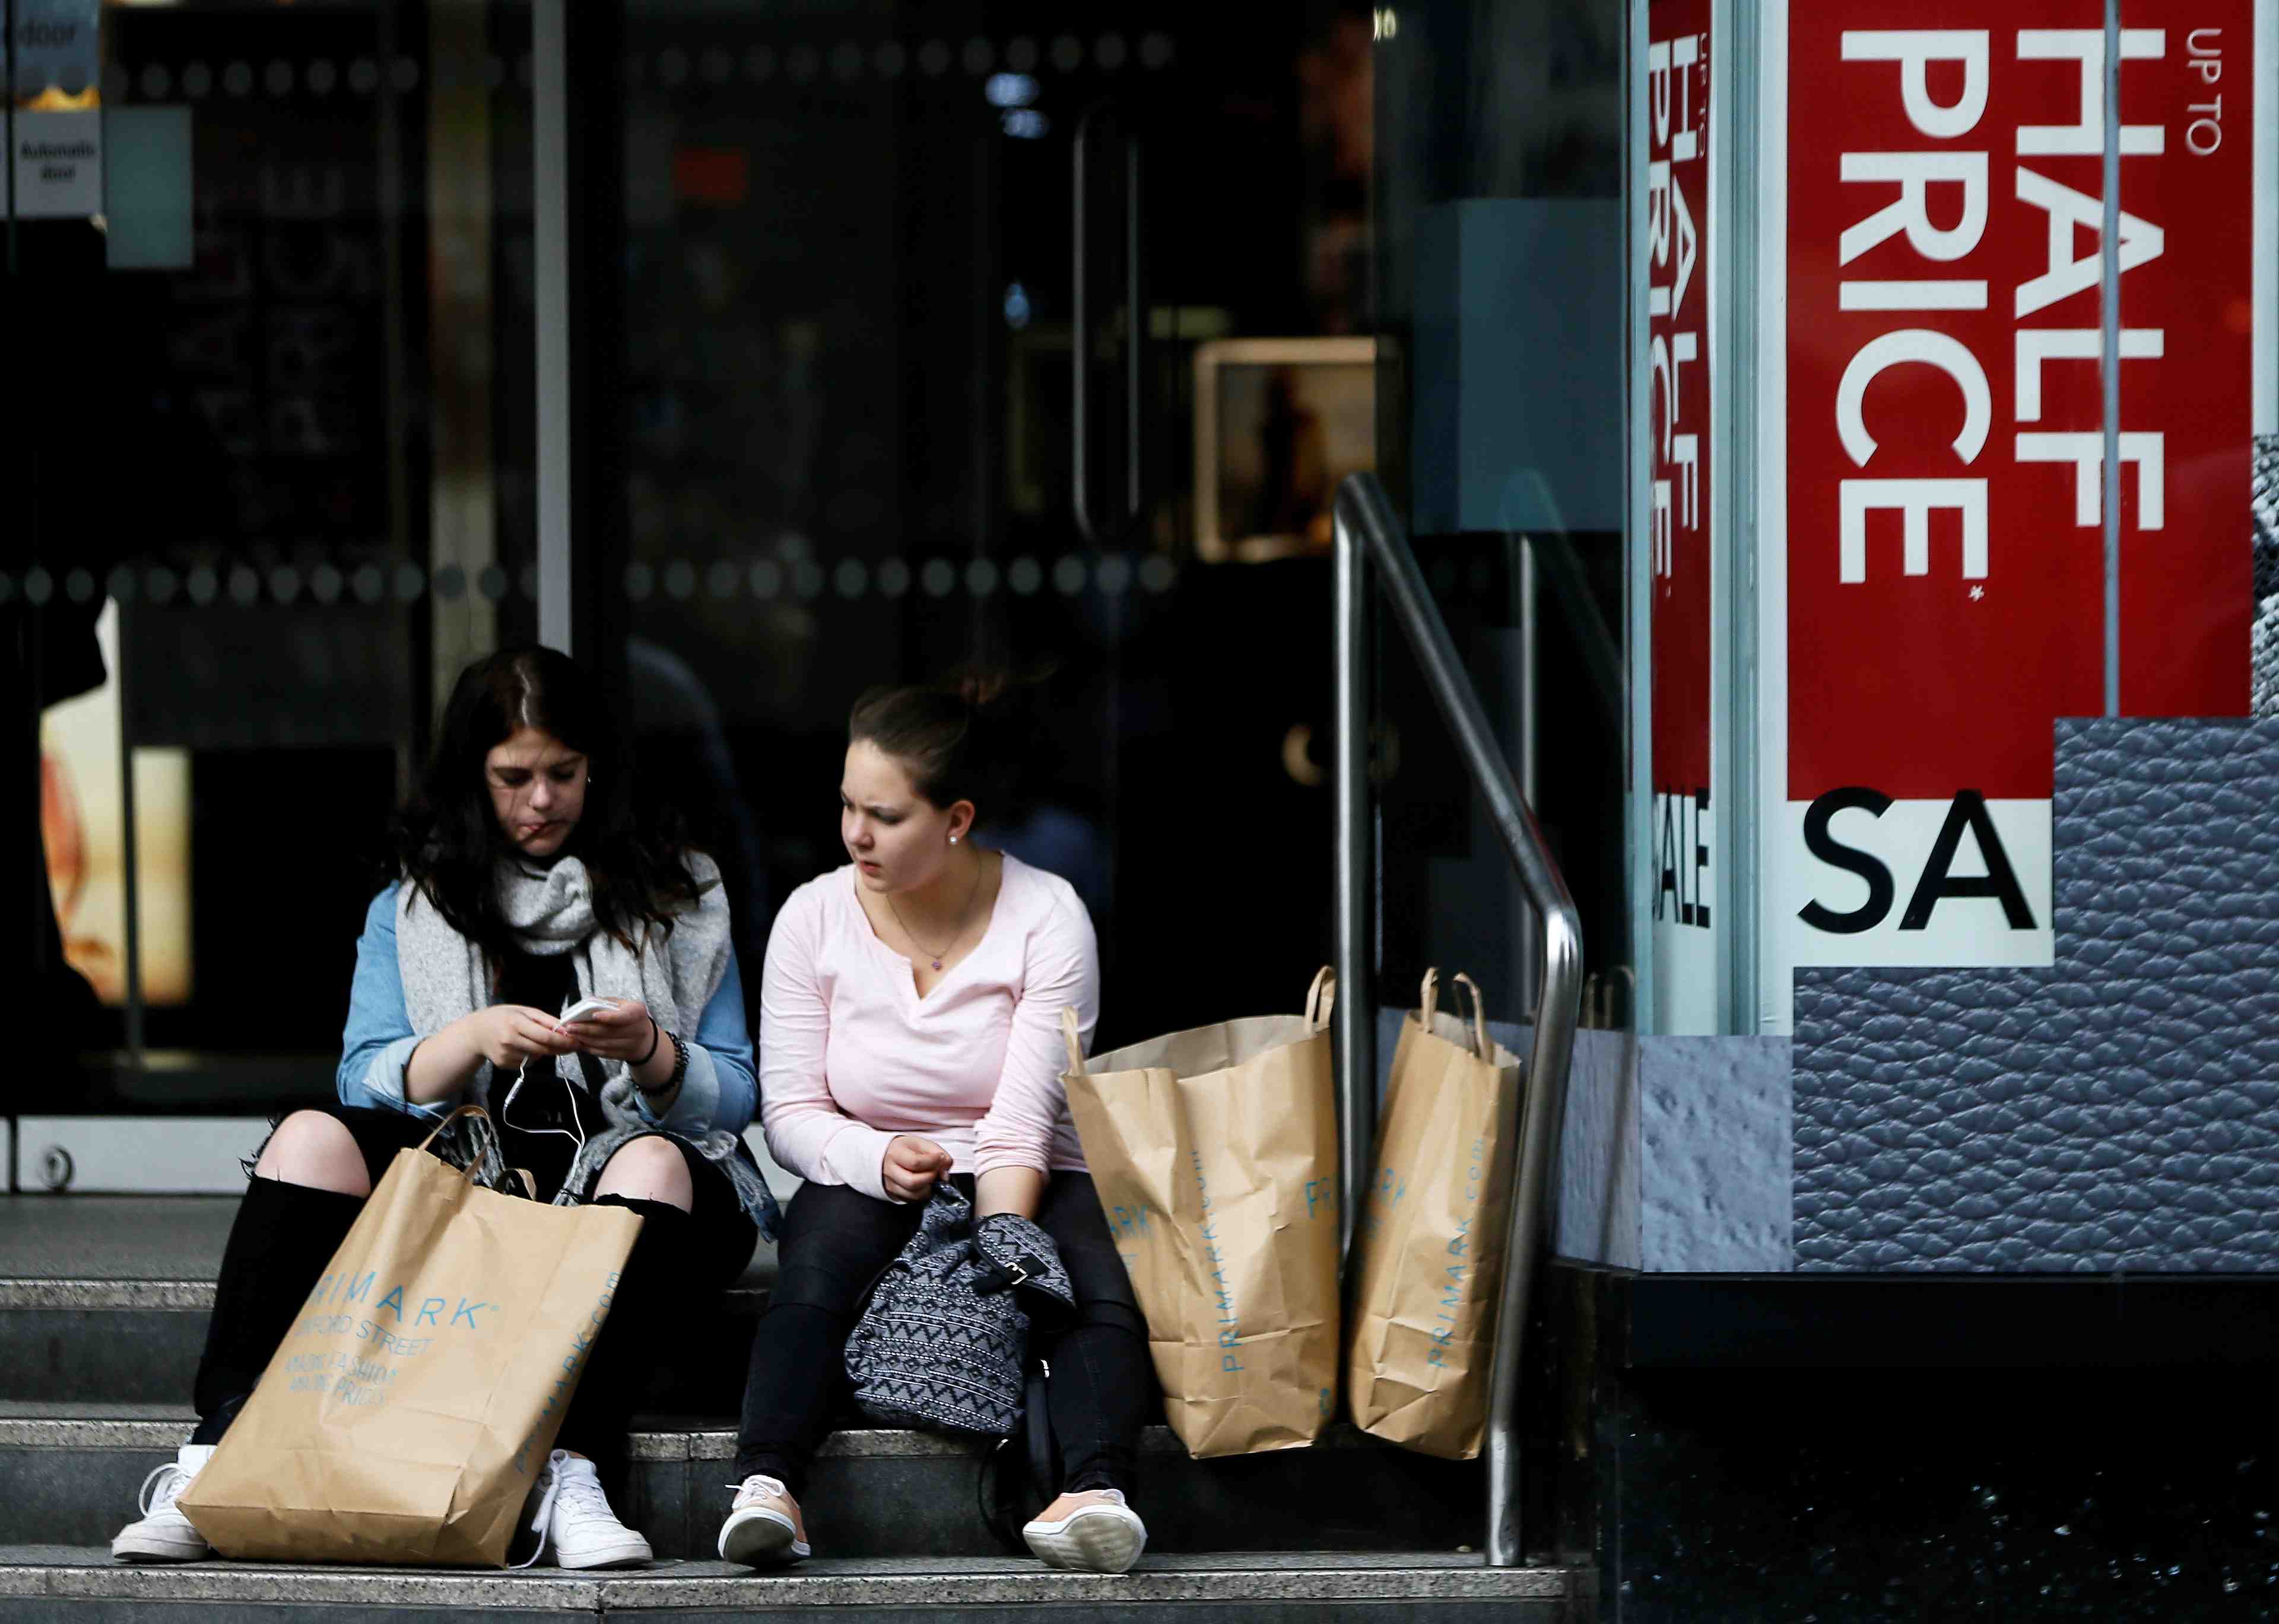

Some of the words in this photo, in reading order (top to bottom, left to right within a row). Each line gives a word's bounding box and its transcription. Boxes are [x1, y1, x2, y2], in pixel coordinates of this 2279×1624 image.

[2186, 28, 2222, 84] UP
[2185, 93, 2222, 156] TO
[1672, 34, 1698, 531] HALF
[2015, 29, 2166, 530] HALF
[1652, 785, 1710, 929] ALE
[313, 1271, 489, 1330] RIMARK
[356, 1319, 435, 1358] STREET
